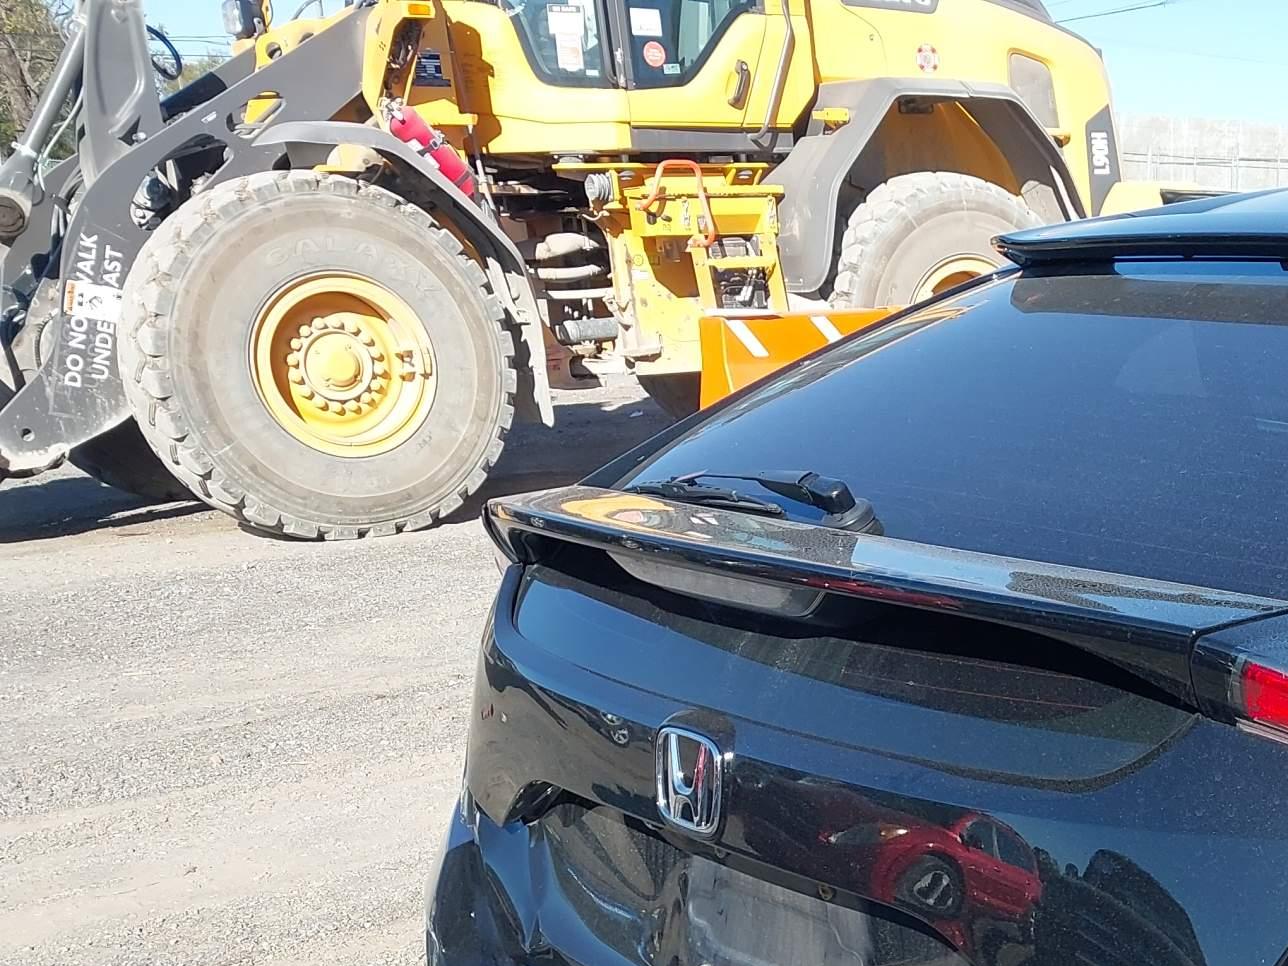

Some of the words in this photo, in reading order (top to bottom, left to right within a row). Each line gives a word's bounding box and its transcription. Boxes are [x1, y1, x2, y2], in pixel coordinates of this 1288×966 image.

[1090, 131, 1110, 175] L90H
[102, 244, 123, 288] AST
[68, 314, 88, 350] NO
[91, 319, 115, 380] UNDE
[64, 353, 84, 388] DO
